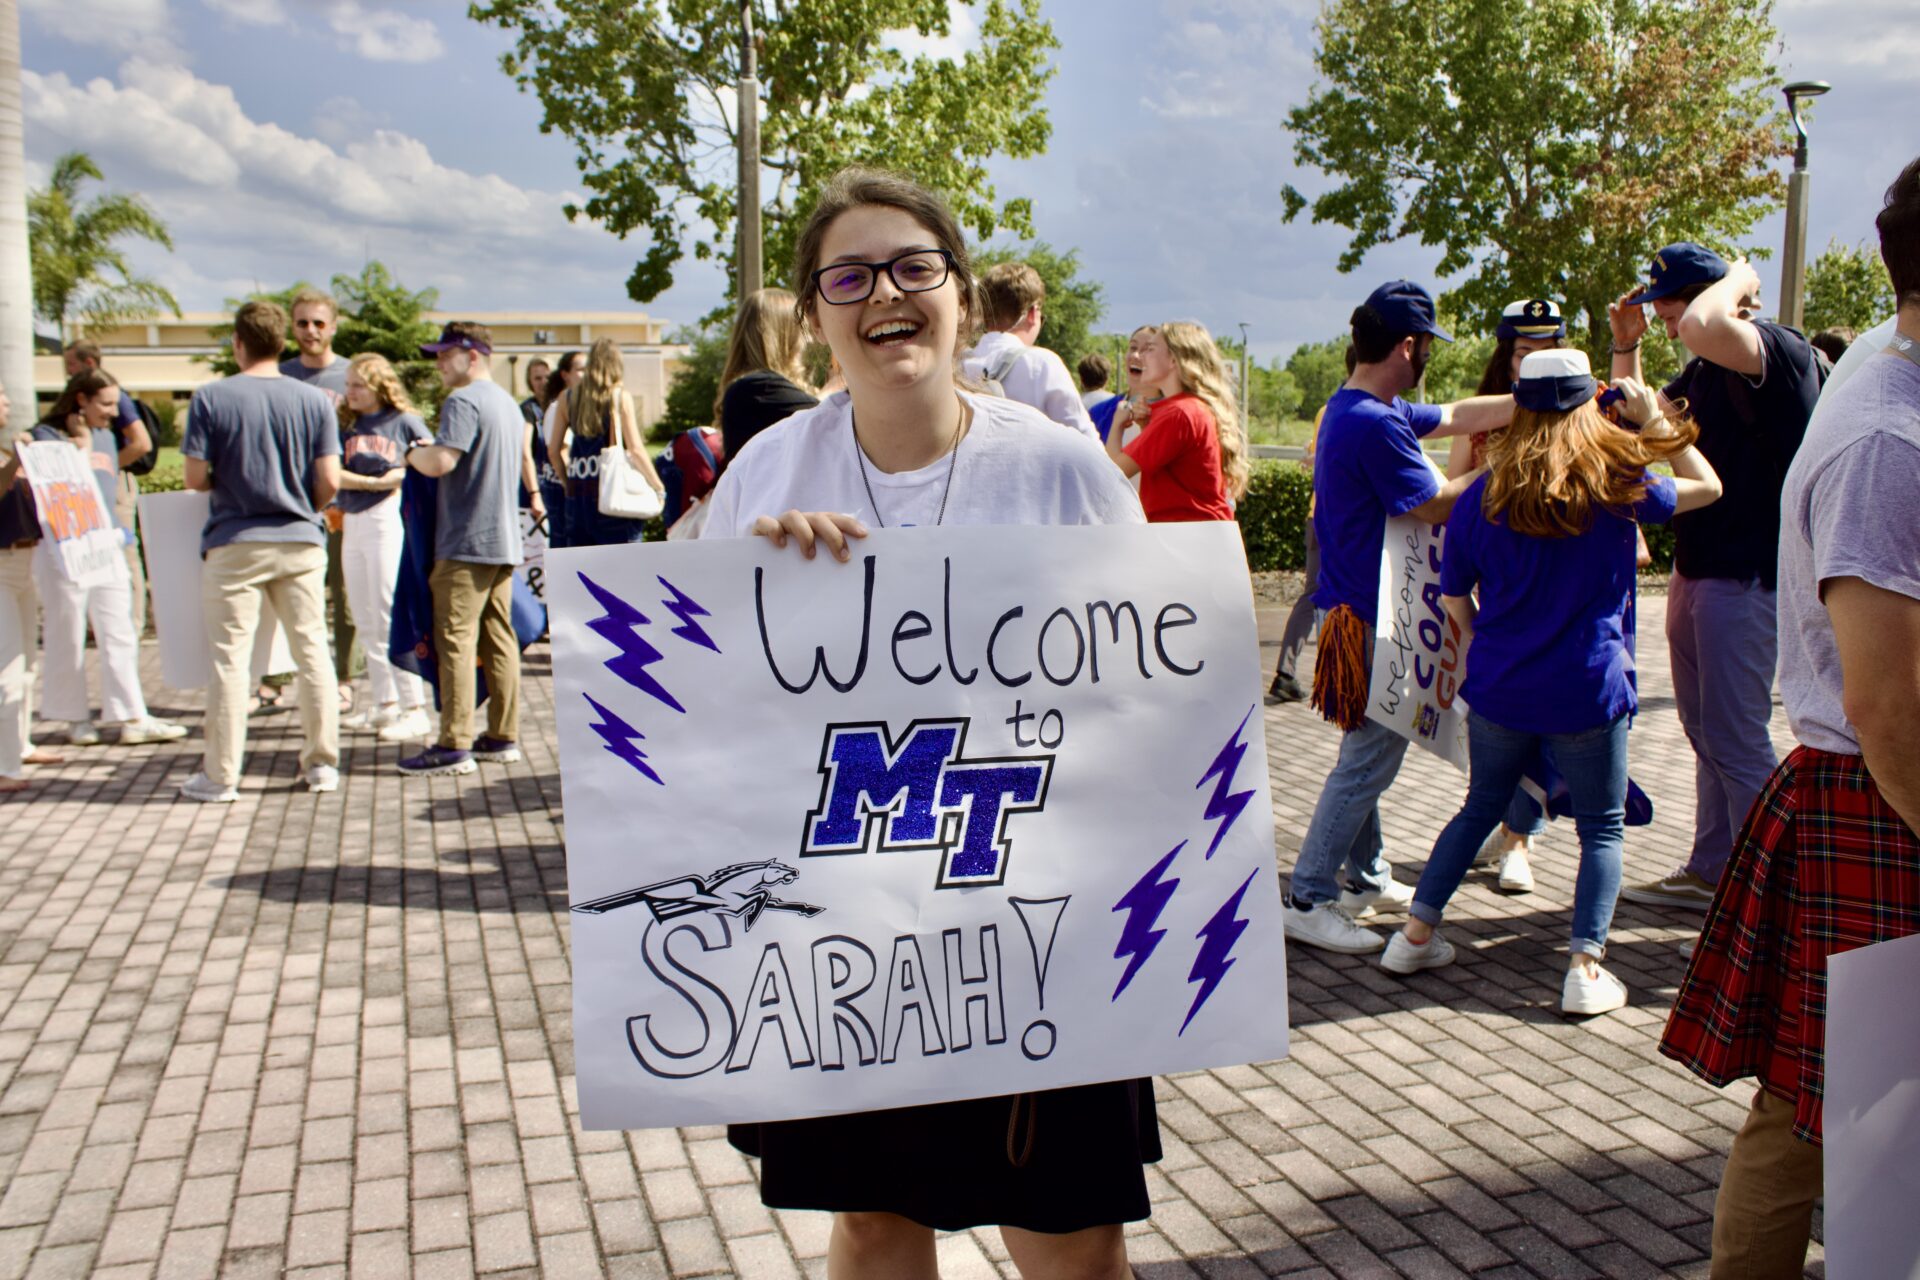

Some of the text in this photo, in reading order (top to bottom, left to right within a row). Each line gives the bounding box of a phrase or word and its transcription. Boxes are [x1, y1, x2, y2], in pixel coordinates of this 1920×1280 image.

[525, 566, 543, 598] &
[754, 557, 1204, 693] Welcome
[1380, 528, 1424, 716] welcome
[1005, 700, 1064, 749] to
[800, 717, 1055, 889] MT
[626, 895, 1072, 1079] SARAH!
